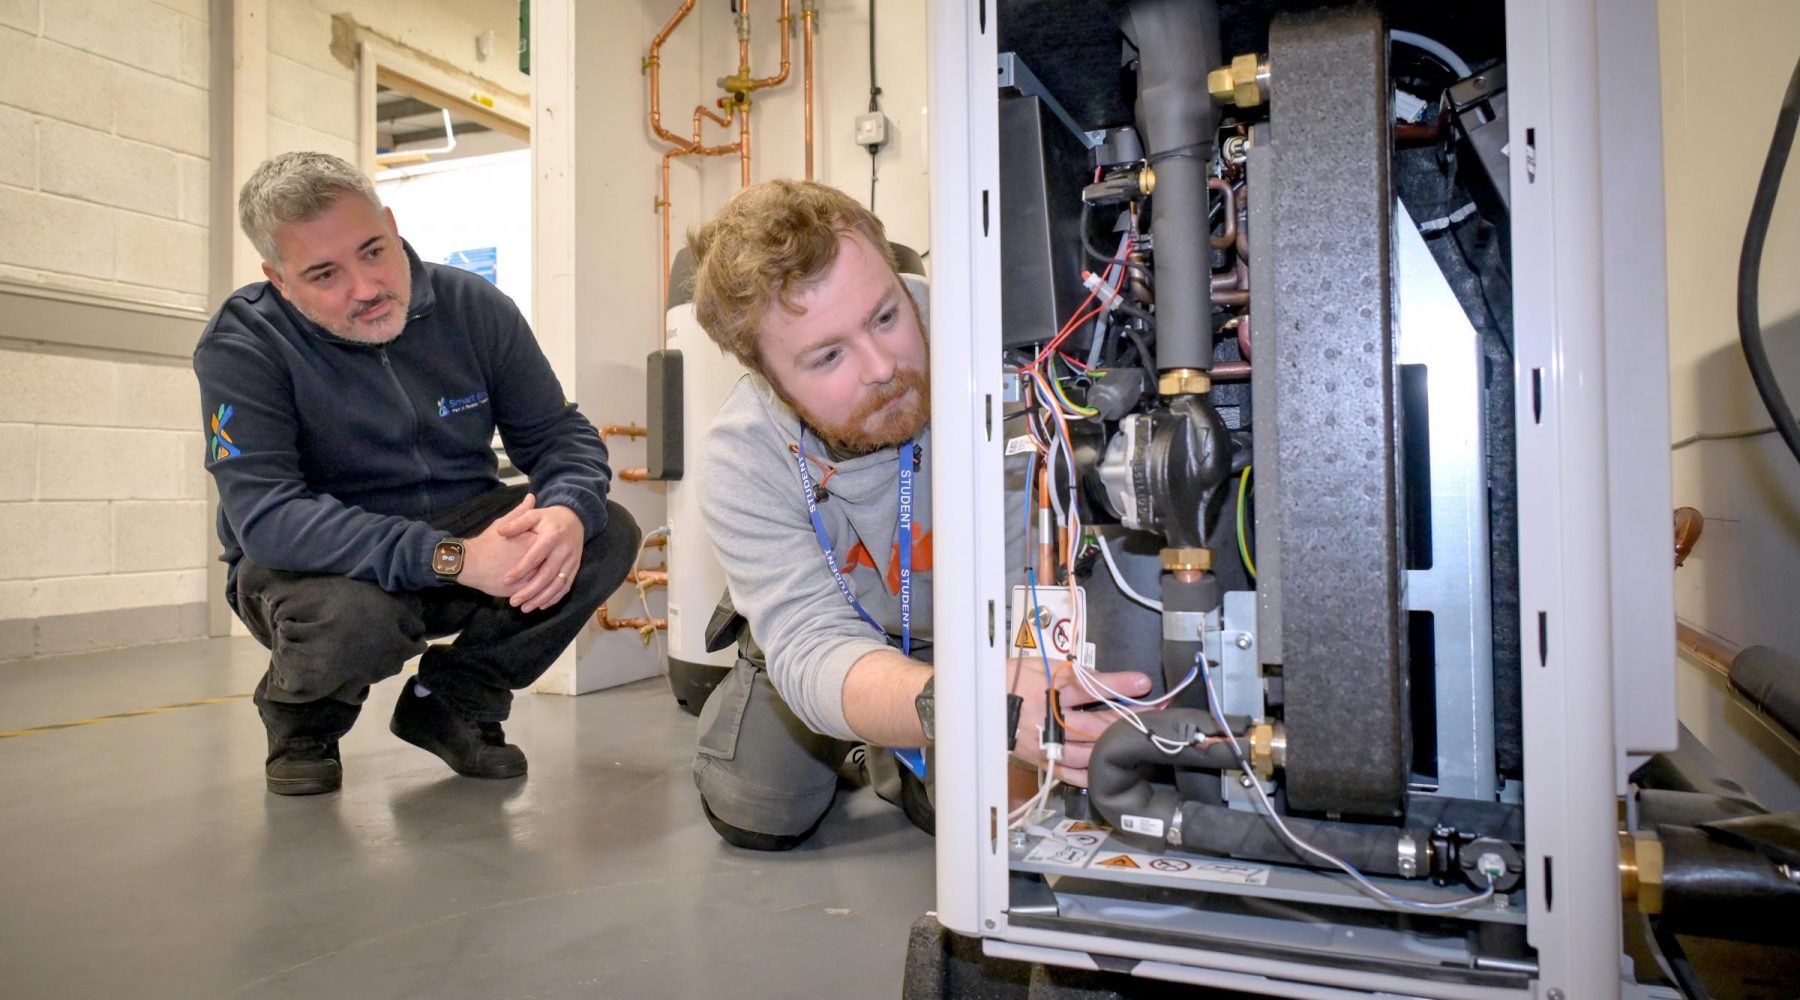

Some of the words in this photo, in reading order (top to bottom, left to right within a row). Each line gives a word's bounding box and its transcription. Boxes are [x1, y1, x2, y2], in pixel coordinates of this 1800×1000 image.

[449, 393, 476, 408] Smart
[799, 456, 816, 513] STUDENT
[900, 469, 912, 531] STUDENT
[824, 549, 855, 603] STUDENT
[901, 568, 910, 631] STUDENT
